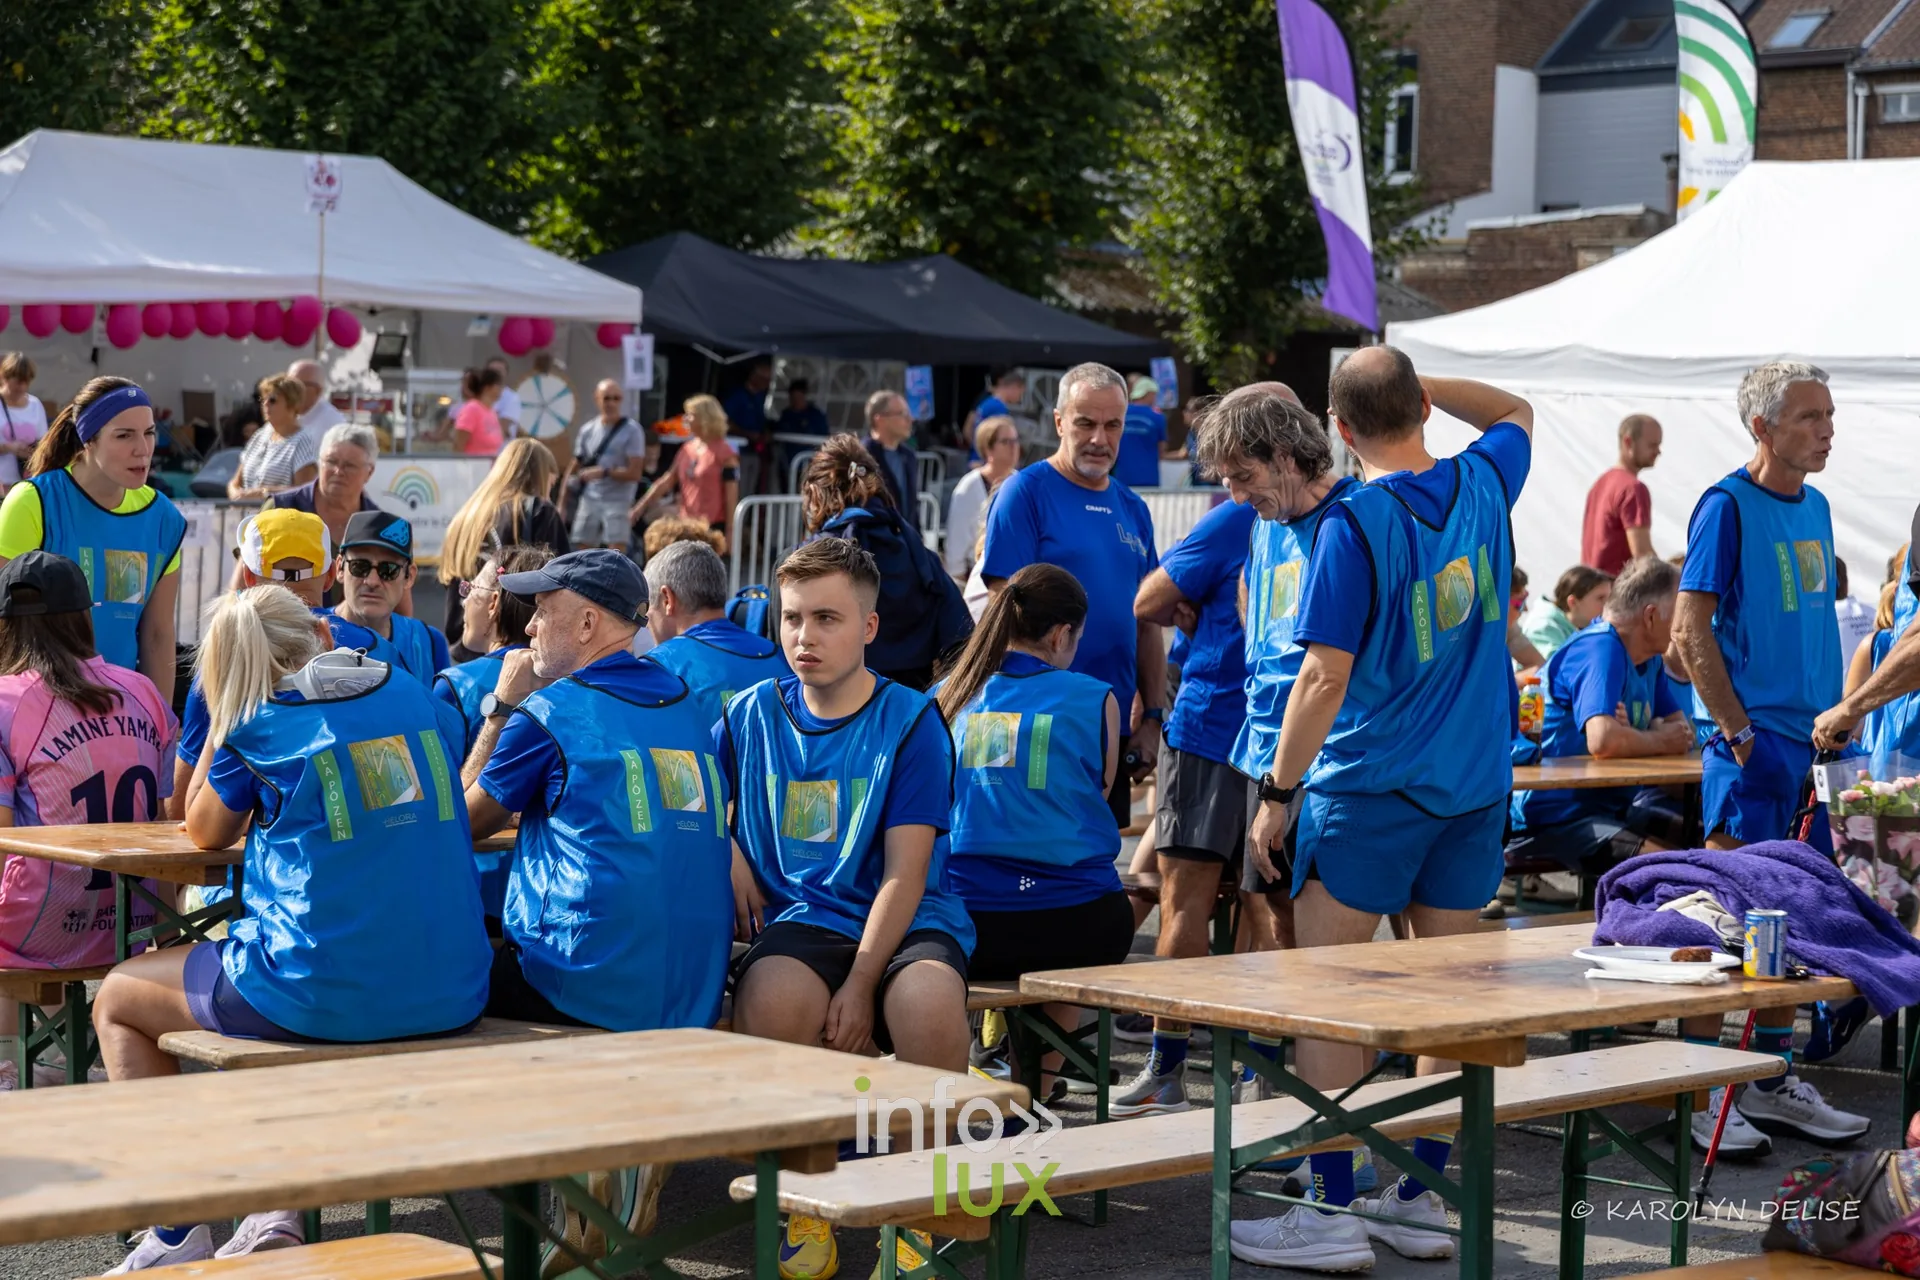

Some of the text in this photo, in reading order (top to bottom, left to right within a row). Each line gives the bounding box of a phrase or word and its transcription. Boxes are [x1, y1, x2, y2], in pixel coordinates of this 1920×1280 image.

[1085, 504, 1107, 513] CRAFT
[40, 716, 113, 762] LAMINE
[90, 914, 155, 932] FOUATION
